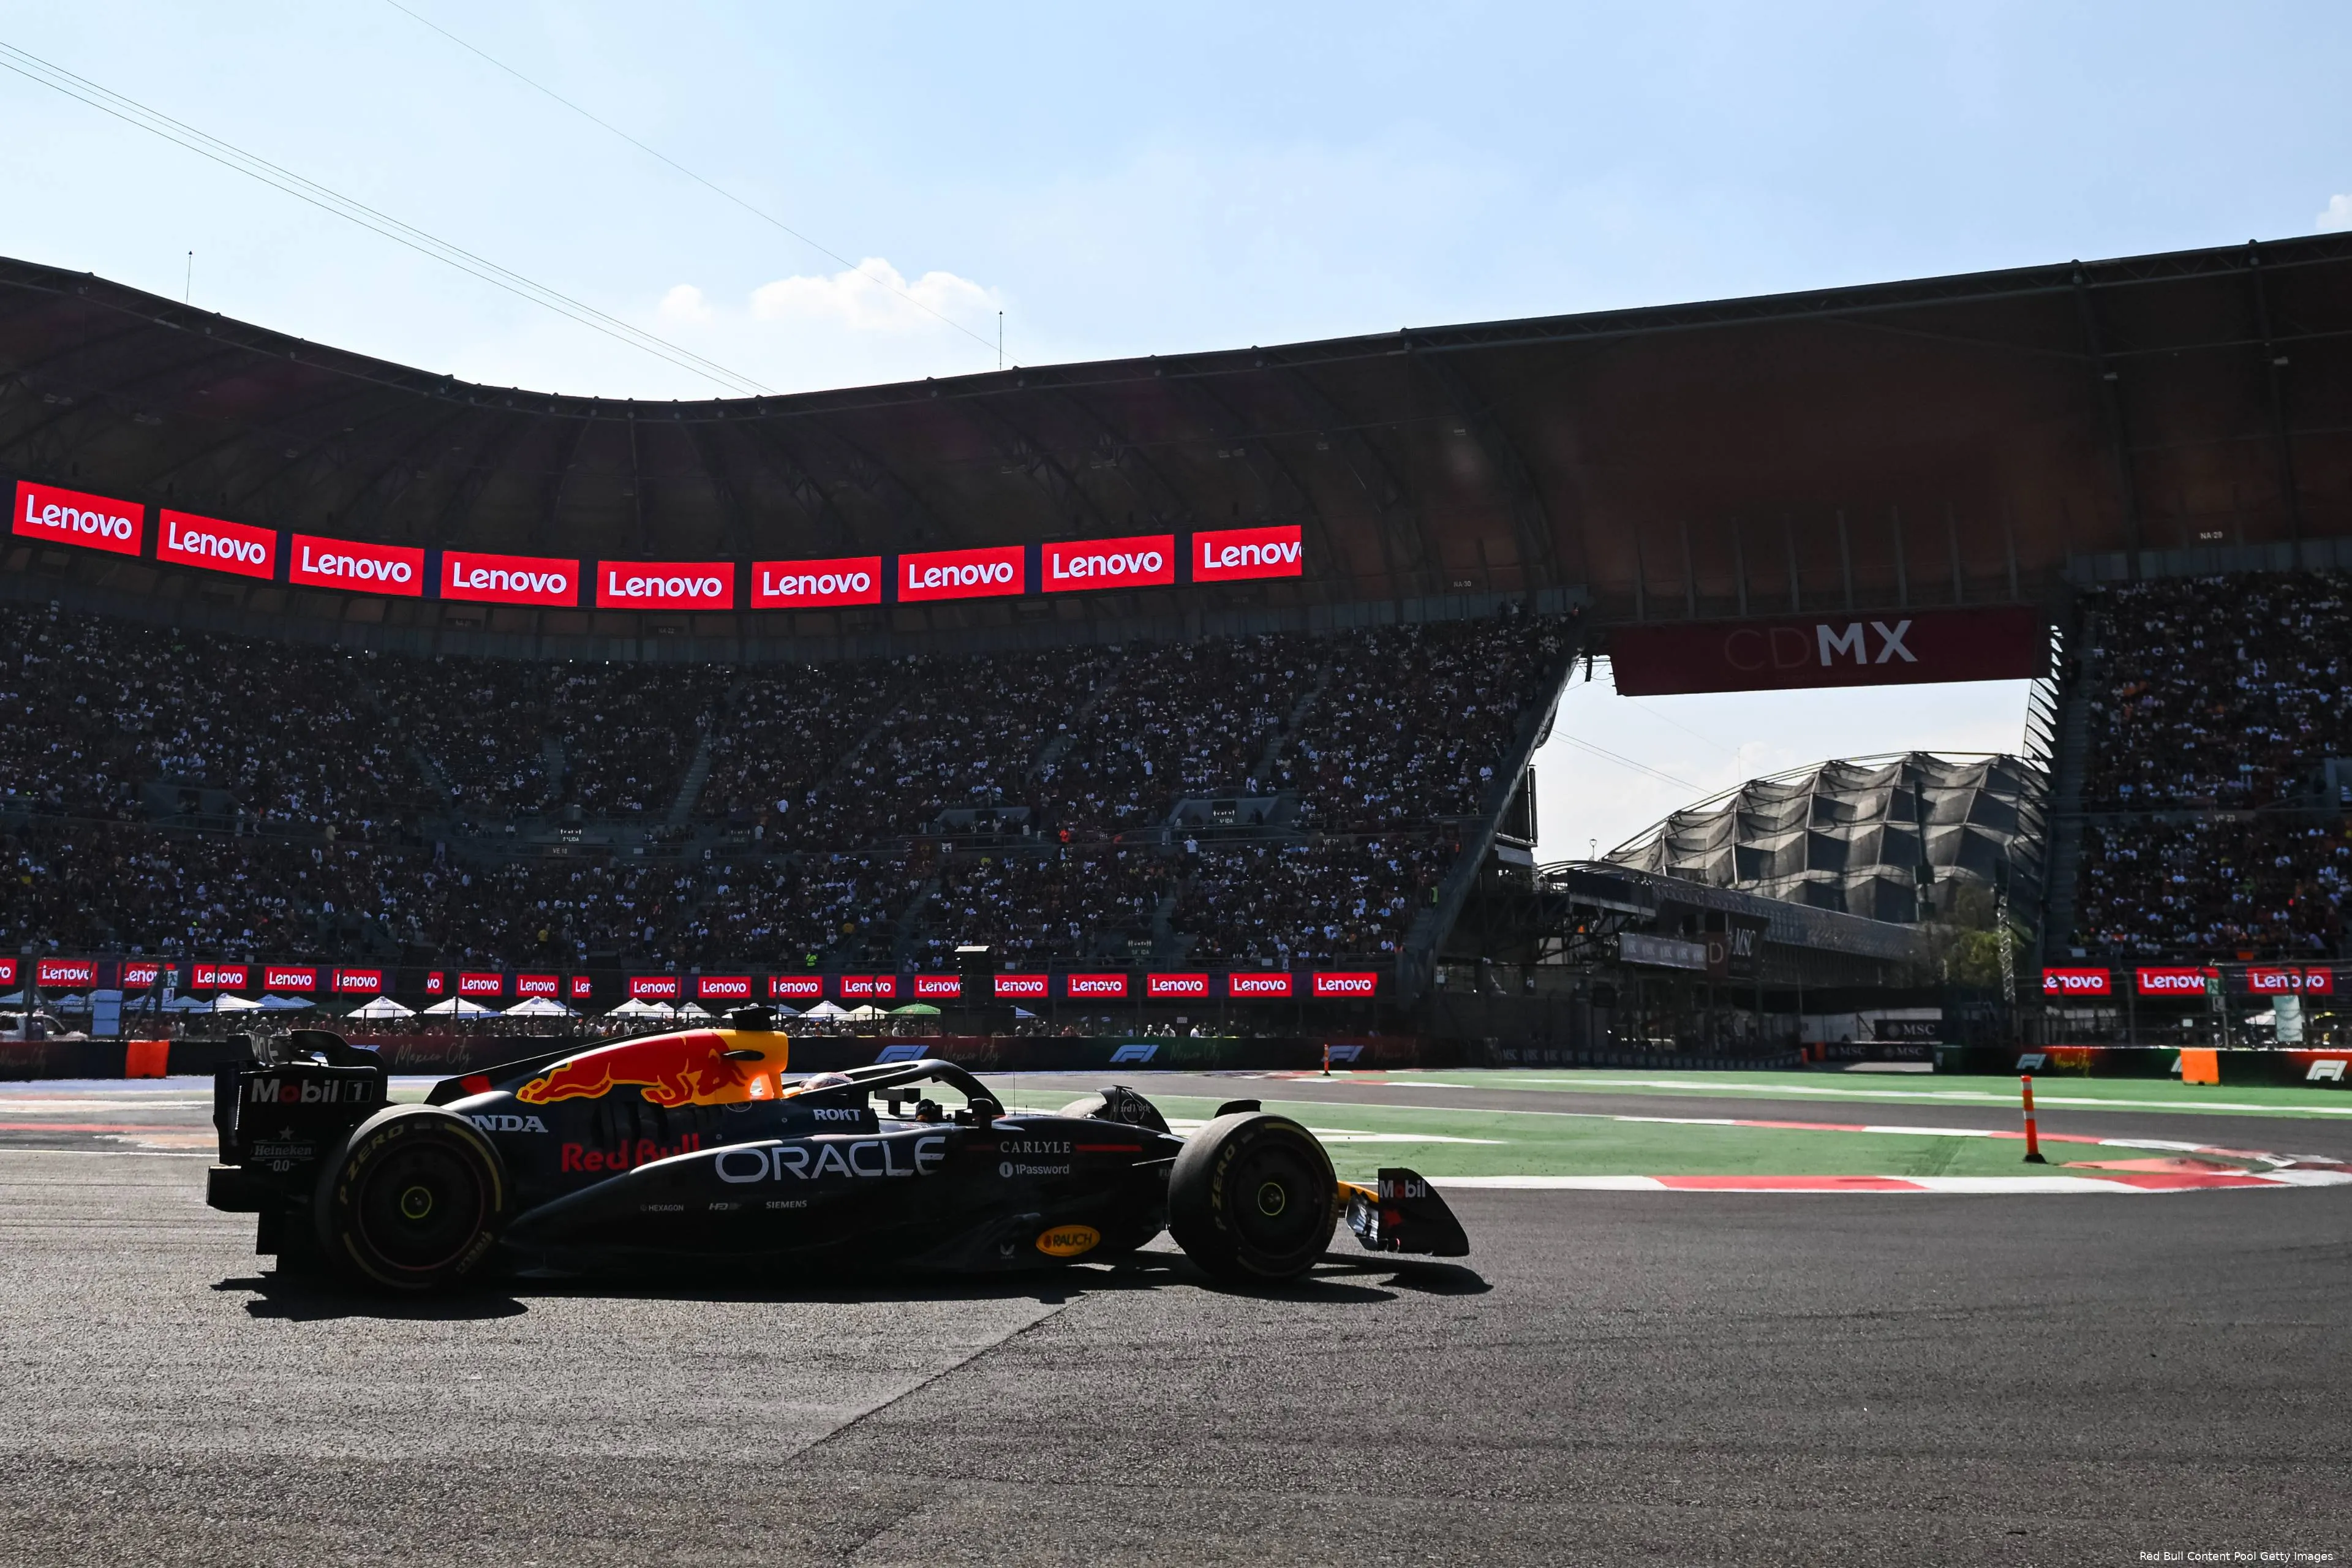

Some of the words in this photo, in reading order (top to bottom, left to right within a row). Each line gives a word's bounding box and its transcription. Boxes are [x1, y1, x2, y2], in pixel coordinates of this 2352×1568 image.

[26, 494, 132, 540] Lenovo
[168, 522, 265, 564] Lenovo
[1205, 541, 1302, 568] Lenov
[303, 546, 412, 582] Lenovo
[1054, 551, 1162, 579] Lenovo
[453, 562, 567, 594] Lenovo
[910, 563, 1013, 589] Lenovo
[609, 571, 722, 597] Lenovo
[764, 571, 870, 596] Lenovo
[1725, 619, 1918, 671] CDMX
[269, 972, 312, 986] Lenovo
[461, 978, 499, 990] Lenovo
[520, 979, 555, 992] Lenovo
[995, 979, 1043, 992] Lenovo
[1072, 979, 1122, 992] Lenovo
[1152, 979, 1203, 992] Lenovo
[1234, 978, 1286, 991] Lenovo
[1318, 978, 1371, 990] Lenovo
[703, 981, 747, 993] Lenovo
[919, 980, 960, 992] Lenov
[1903, 1023, 1936, 1036] MSC
[1896, 1046, 1924, 1056] MSC
[250, 1078, 339, 1104] Mobil
[813, 1108, 861, 1121] ROKT
[470, 1115, 549, 1133] NDA
[254, 1144, 312, 1156] Heineken
[1000, 1140, 1071, 1153] CARLYLE
[560, 1139, 630, 1173] Red
[715, 1136, 946, 1184] ORACLE
[1014, 1163, 1070, 1175] 1Password
[1379, 1179, 1427, 1199] Mobil
[648, 1204, 684, 1212] HEXAGON
[765, 1199, 808, 1209] SIEMENS
[1052, 1232, 1093, 1248] RAUCH
